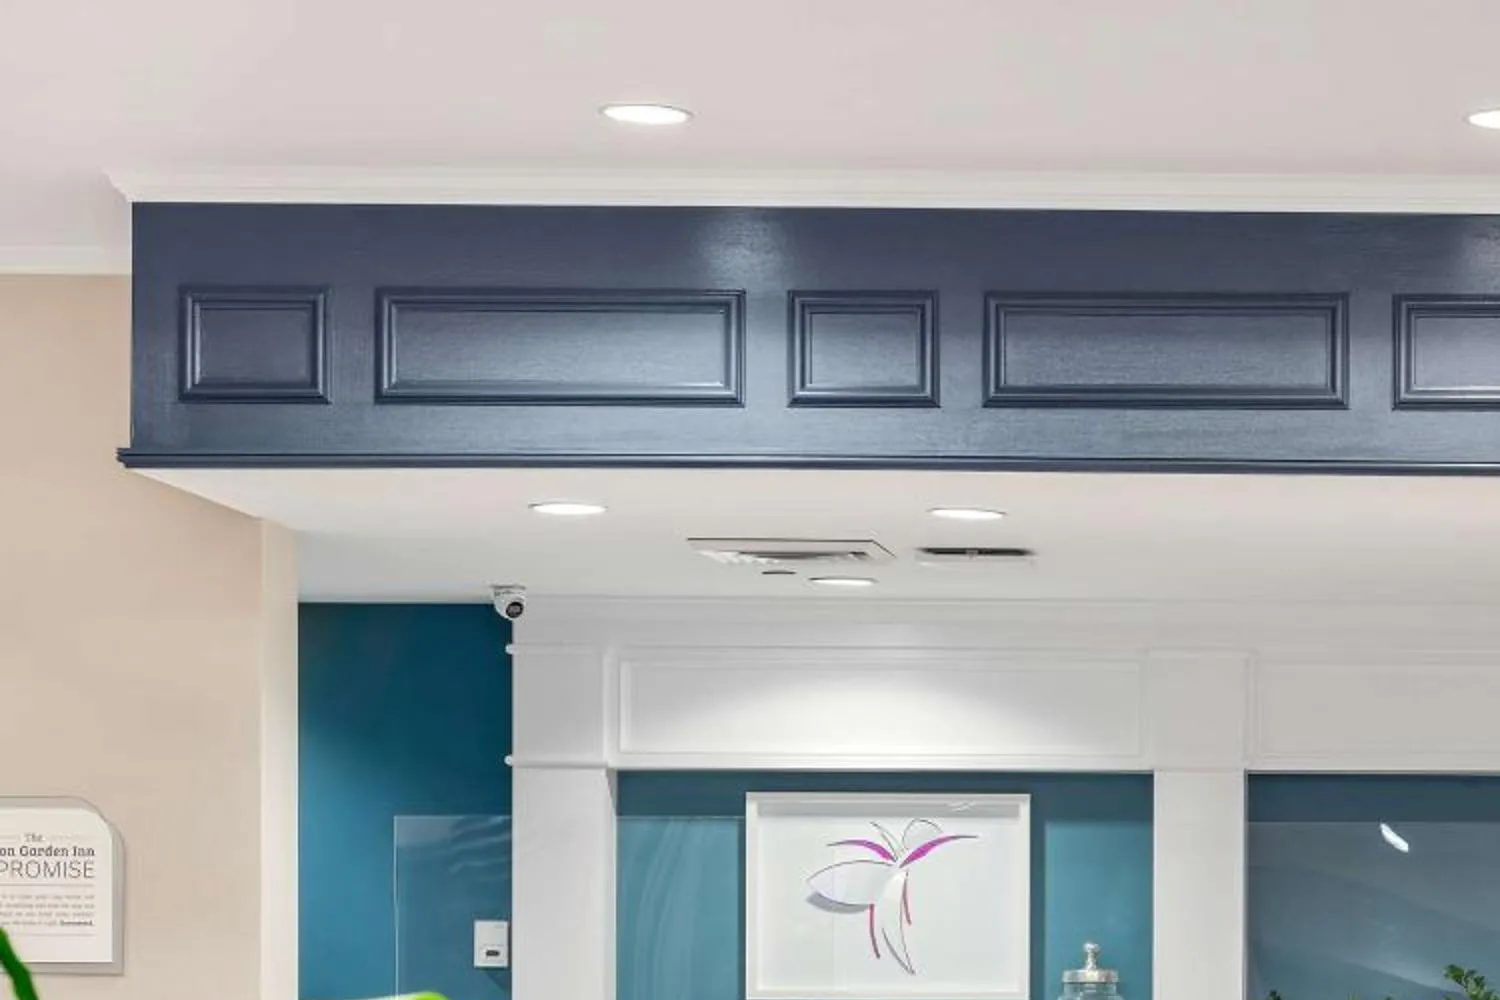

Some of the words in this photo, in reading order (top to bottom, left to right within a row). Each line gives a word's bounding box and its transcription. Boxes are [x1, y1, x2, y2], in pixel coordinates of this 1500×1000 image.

[20, 845, 69, 857] Garden
[72, 845, 95, 857] Inn
[0, 860, 95, 879] PROMISE
